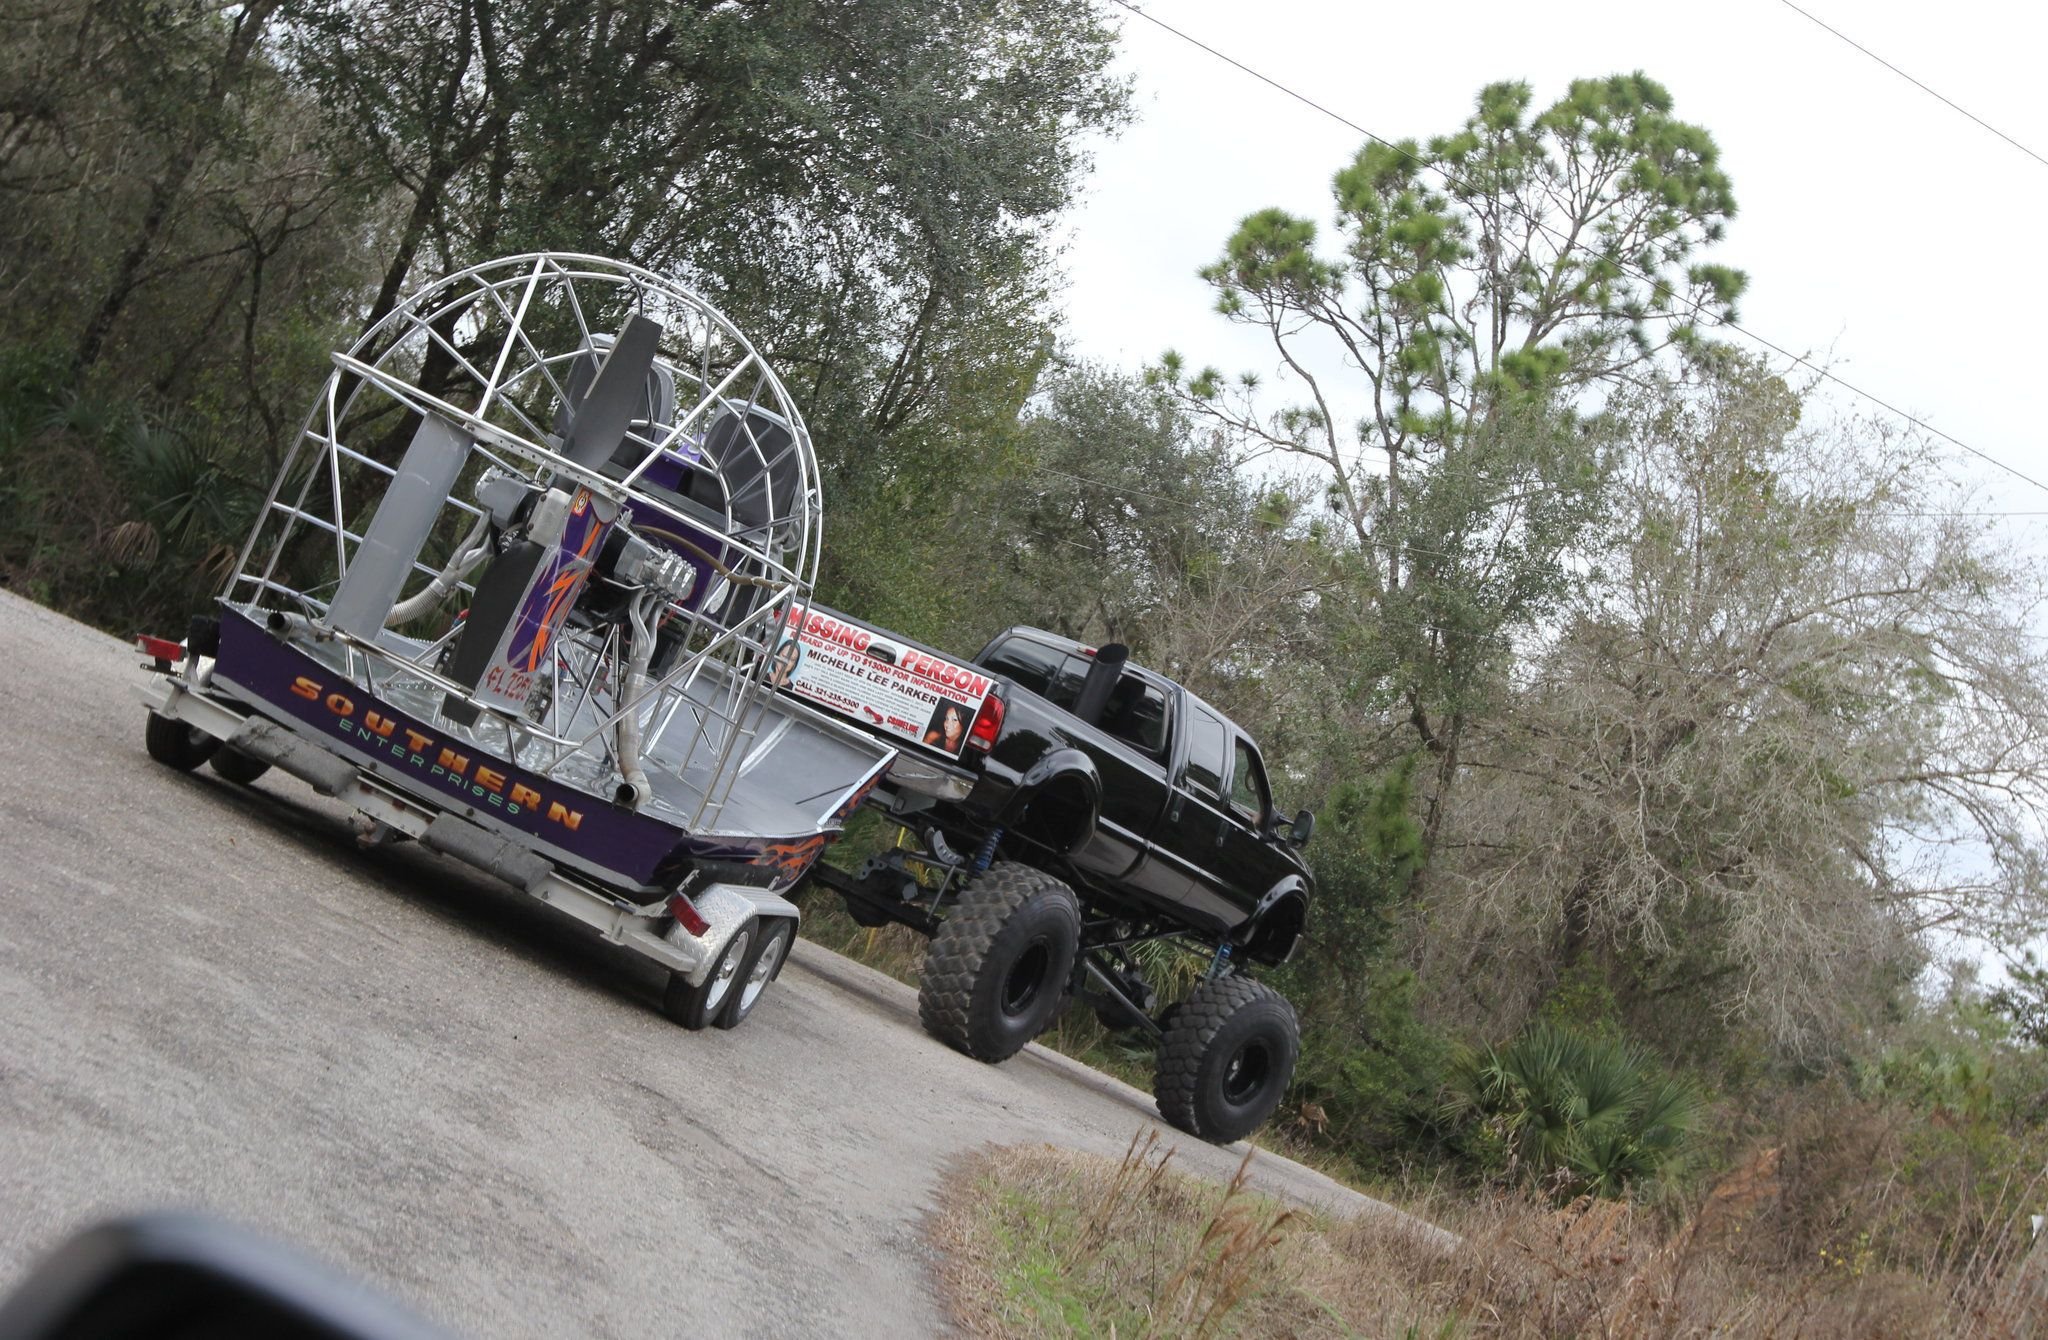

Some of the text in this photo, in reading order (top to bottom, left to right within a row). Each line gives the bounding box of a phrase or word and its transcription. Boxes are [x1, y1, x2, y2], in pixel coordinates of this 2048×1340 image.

[487, 666, 503, 693] FL
[786, 607, 871, 651] MISSING
[901, 650, 989, 697] PERSON
[789, 629, 968, 704] RWARD OF UP TO $13000 FOR INFORMATION
[795, 680, 813, 692] CALL
[807, 650, 937, 705] MICHELLE LEE PARKER
[289, 675, 584, 831] SOUTHERN
[339, 717, 520, 815] ENTERPRISES
